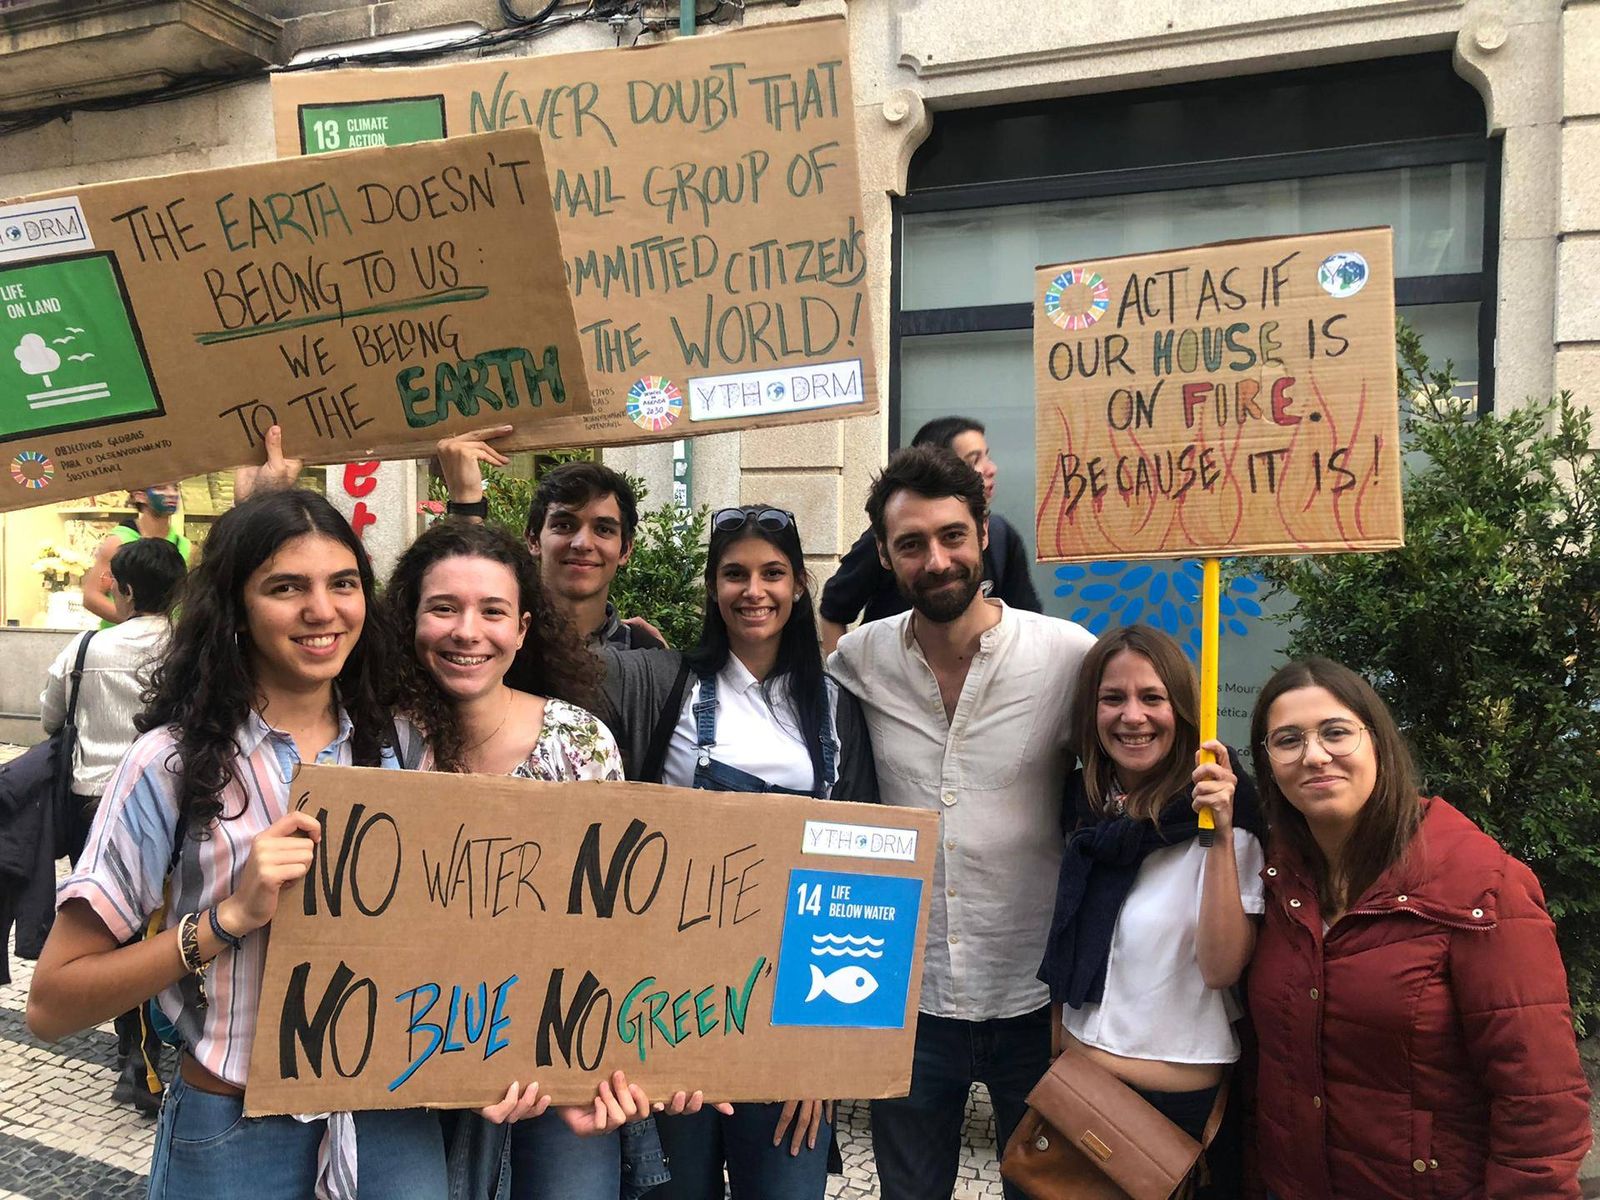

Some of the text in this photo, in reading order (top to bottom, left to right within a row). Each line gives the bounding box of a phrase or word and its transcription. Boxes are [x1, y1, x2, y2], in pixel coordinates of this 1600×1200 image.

[347, 117, 389, 131] CLIMATE
[470, 60, 842, 147] NEVER DOUBT THAT
[313, 119, 341, 150] 13
[348, 133, 386, 148] ACTION
[111, 152, 530, 263] THE EARTH DOESN'T
[552, 141, 840, 228] MALL GROUP OF
[23, 215, 79, 242] DRM
[563, 216, 867, 299] MMITTED CITIZENS
[0, 283, 27, 302] LIFE
[6, 297, 61, 319] ON LAND
[204, 248, 347, 330] BELONG
[343, 248, 396, 296] TO
[1116, 250, 1301, 329] ACT AS IF
[279, 313, 464, 380] WE BELONG
[579, 290, 863, 374] THE WORLD!
[1048, 313, 1350, 382] OUR HOUSE IS
[218, 345, 567, 449] TO THE EARTH
[697, 369, 857, 412] YTH DRM
[1107, 375, 1323, 431] ON FIRE.
[60, 459, 81, 471] PARA
[1059, 434, 1382, 517] BECAUSE IT IS!
[810, 827, 914, 855] YTH DRM
[421, 822, 546, 921] WATER
[566, 817, 668, 919] NO
[676, 842, 765, 933] LIFE
[797, 882, 823, 917] 14
[831, 885, 852, 900] LIFE
[829, 902, 896, 921] BELOW WATER
[279, 960, 378, 1081] NO
[388, 974, 520, 1092] BLUE
[535, 966, 612, 1072] NO
